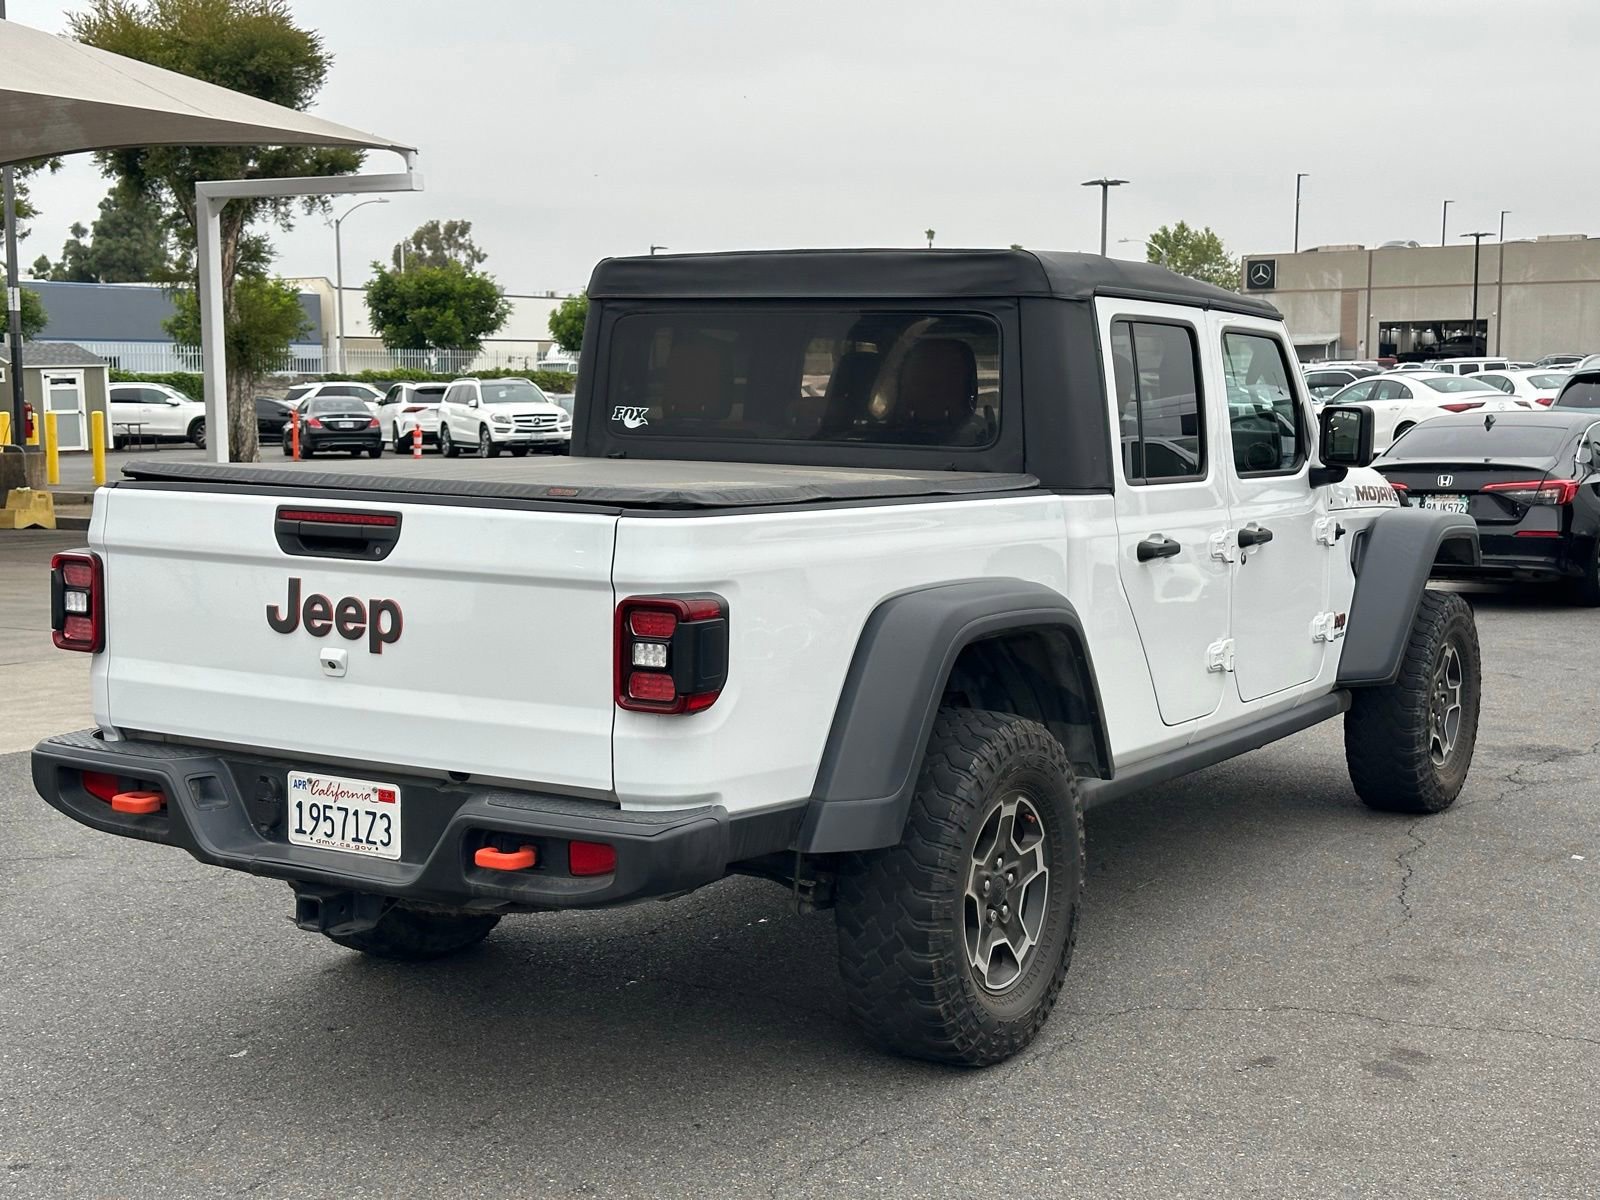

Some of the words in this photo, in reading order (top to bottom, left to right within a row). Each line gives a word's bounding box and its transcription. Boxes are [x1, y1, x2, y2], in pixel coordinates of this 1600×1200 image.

[612, 406, 650, 421] FOX
[1355, 486, 1398, 503] MOJAVE
[266, 577, 403, 654] Jeep
[293, 779, 308, 790] APR
[310, 780, 378, 803] California
[295, 801, 392, 847] 19571Z3
[315, 839, 373, 851] dmv.ca.gov
